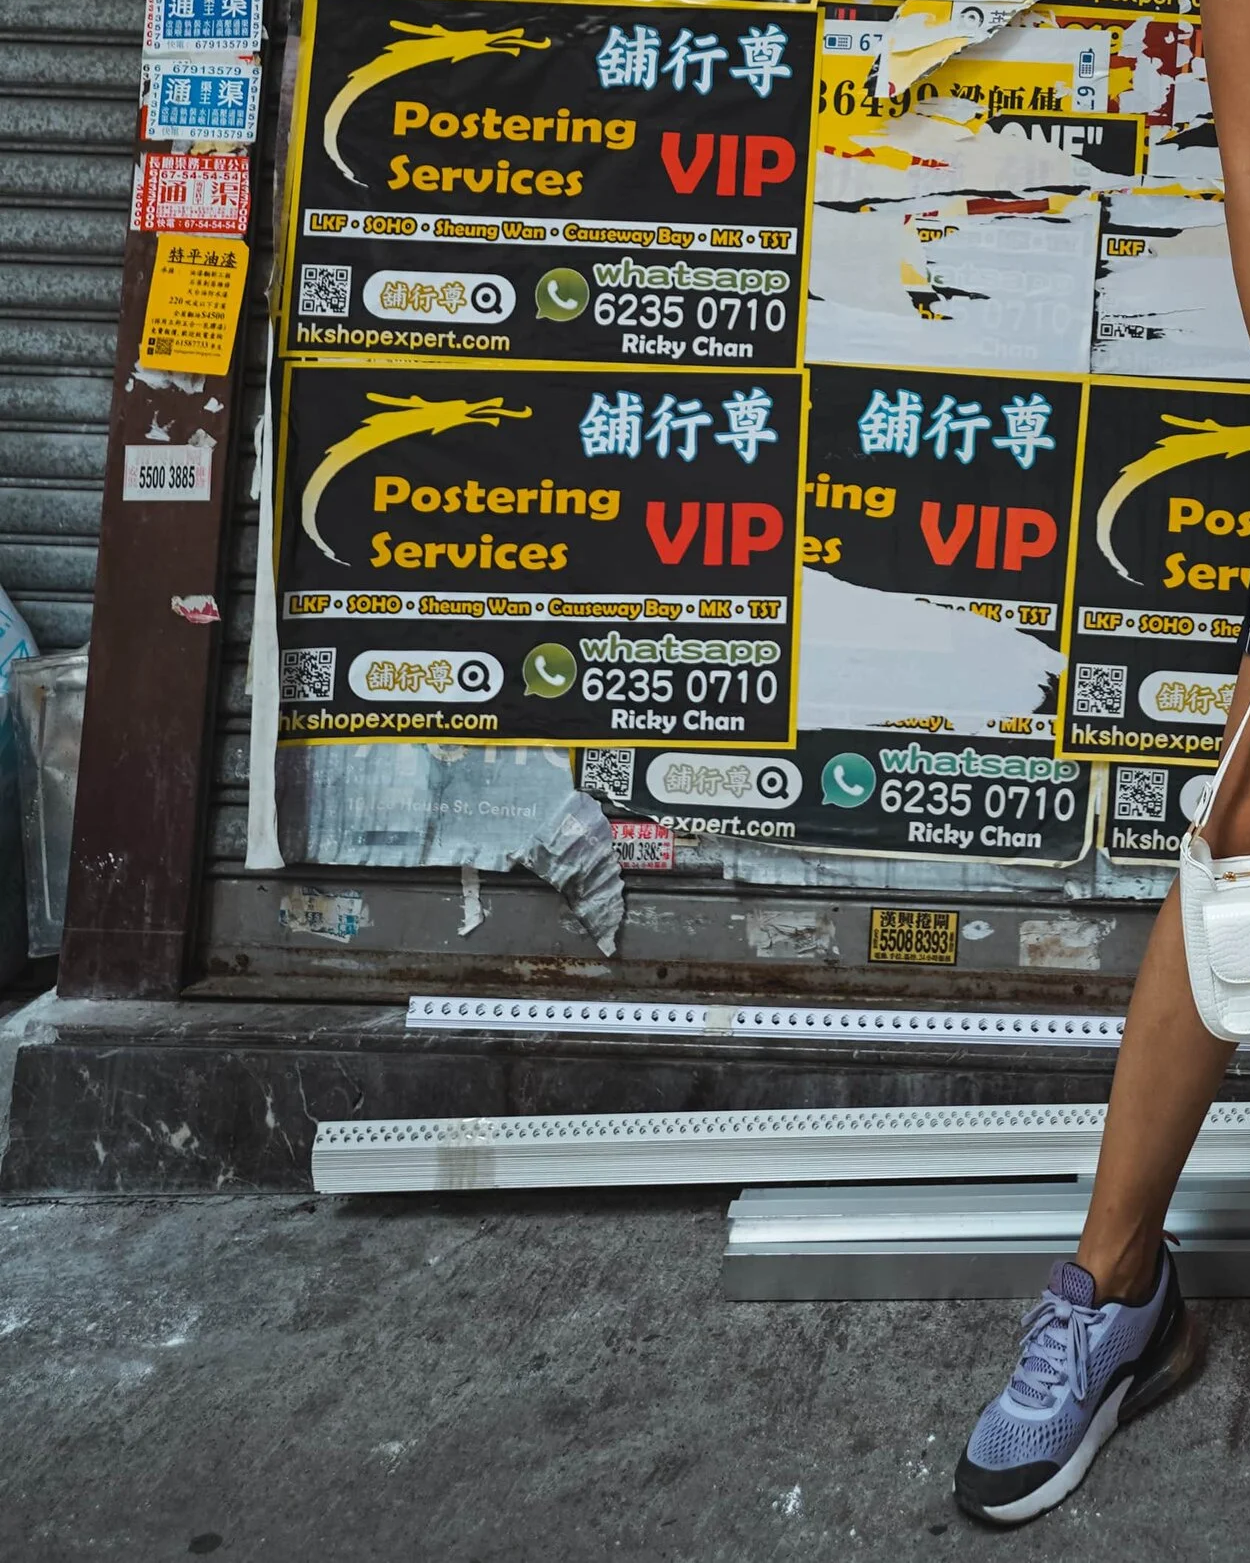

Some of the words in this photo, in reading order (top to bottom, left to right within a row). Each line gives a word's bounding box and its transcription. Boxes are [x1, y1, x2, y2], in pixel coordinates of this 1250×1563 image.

[195, 40, 249, 50] 67913579
[596, 22, 793, 99] 舖行尊
[173, 65, 241, 75] 67913579
[190, 129, 243, 139] 67913579
[392, 99, 637, 151] Postering
[161, 170, 239, 181] 67-54-54-54
[387, 153, 584, 197] Services
[660, 131, 796, 198] VIP
[309, 213, 347, 234] LKF
[363, 215, 417, 237] SOHO
[434, 218, 499, 242] Sheung
[502, 222, 546, 241] Wan
[562, 223, 654, 249] Causeway
[656, 227, 693, 250] Bay
[710, 228, 744, 249] MK
[759, 230, 791, 251] TST
[593, 256, 791, 296] whatsapp
[593, 293, 685, 328] 6235
[696, 296, 787, 333] 0710
[296, 322, 511, 355] hkshopexpert.com
[622, 333, 686, 360] Ricky
[691, 335, 754, 359] Chan
[579, 387, 780, 465] 舖行尊
[857, 387, 1058, 471] 舖行尊
[139, 464, 166, 490] 5500
[168, 464, 196, 490] 3885
[372, 475, 621, 522] Postering
[370, 530, 569, 572] Services
[644, 501, 784, 567] VIP
[919, 501, 1058, 573] VIP
[289, 594, 330, 615] LKF
[346, 594, 402, 615] SOHO
[419, 596, 485, 619] Sheung
[487, 598, 531, 618] Wan
[548, 598, 642, 622] Causeway
[644, 599, 682, 622] Bay
[699, 599, 732, 620] MK
[748, 600, 782, 620] TST
[1083, 611, 1122, 633] LKF
[1139, 613, 1195, 636] SOHO
[580, 630, 781, 669] whatsapp
[581, 668, 675, 704] 6235
[685, 669, 779, 705] 0710
[279, 707, 499, 733] hkshopexpert.com
[610, 707, 680, 735] Ricky
[684, 708, 746, 734] Chan
[878, 743, 1080, 784] whatsapp
[478, 801, 537, 819] Central
[880, 778, 972, 818] 6235
[985, 782, 1076, 825] 0710
[908, 819, 974, 850] Ricky
[980, 824, 1043, 850] Chan
